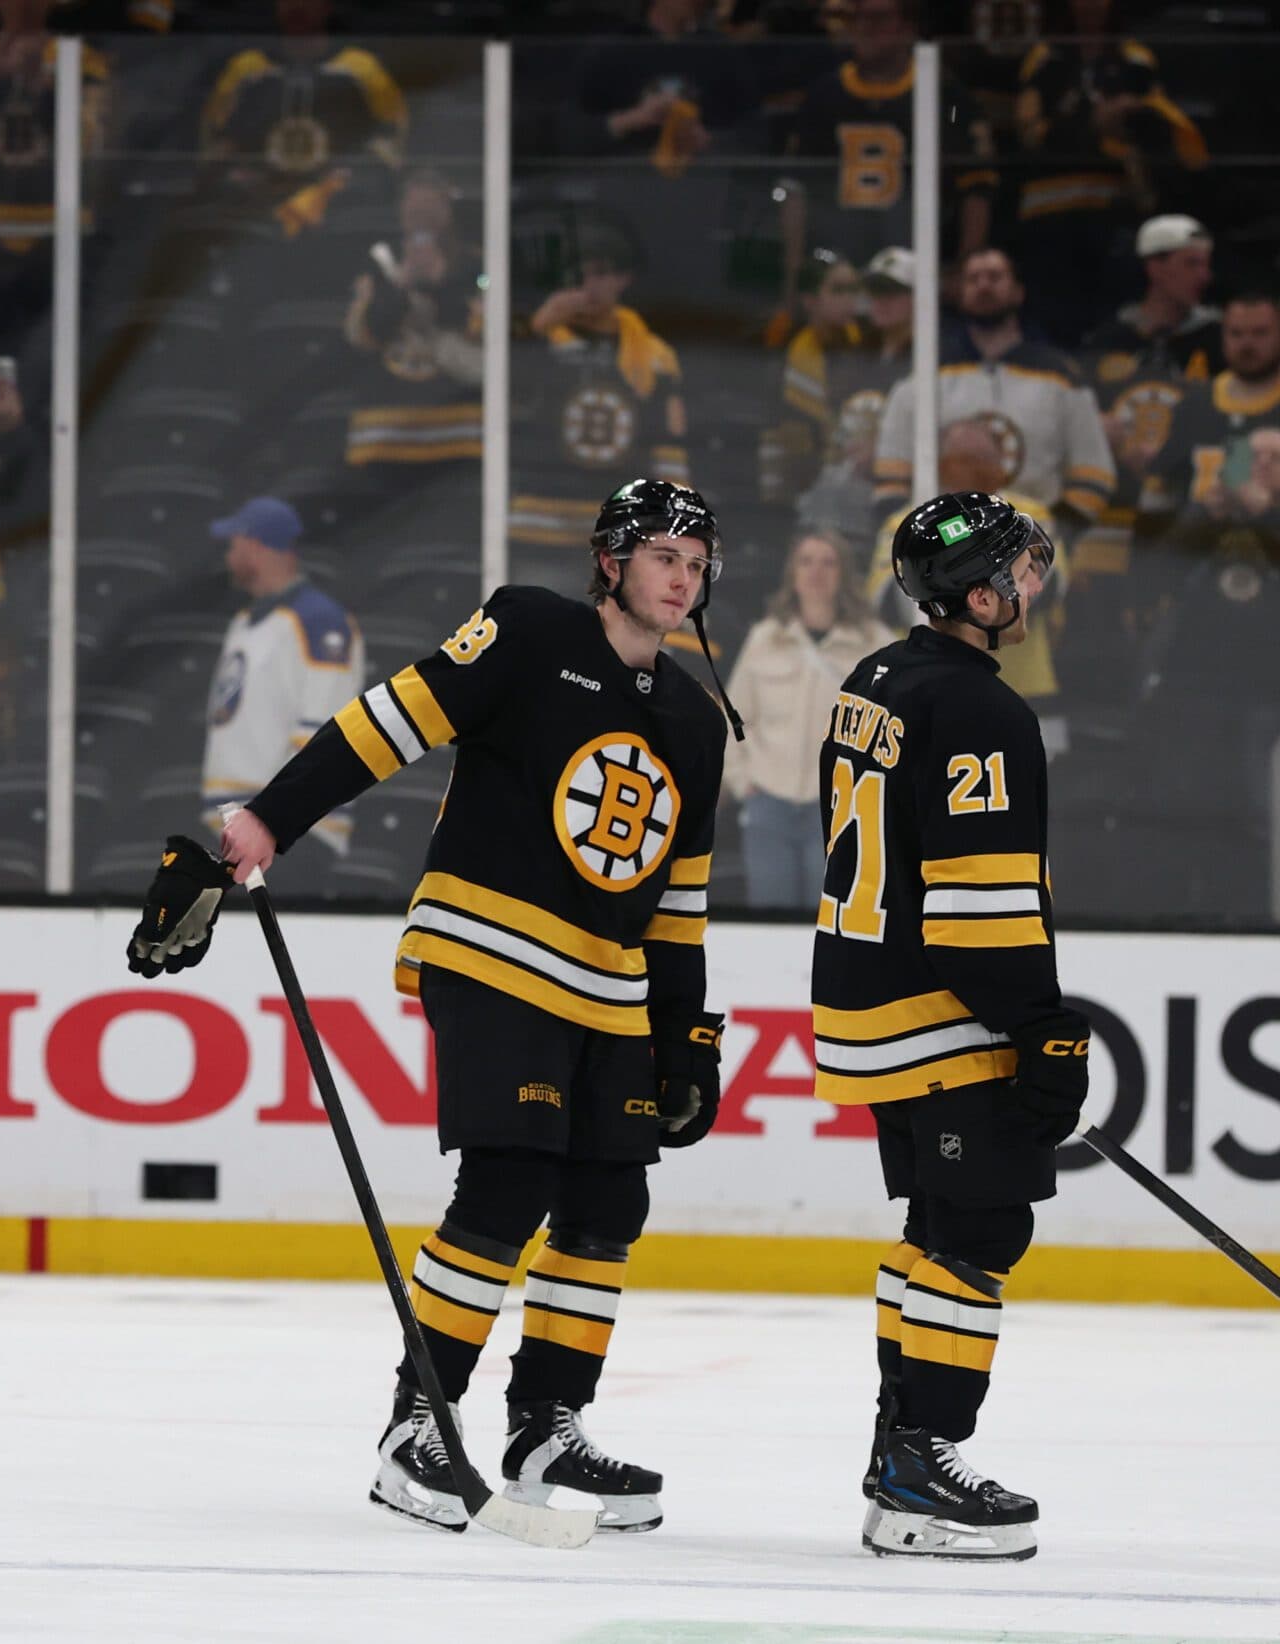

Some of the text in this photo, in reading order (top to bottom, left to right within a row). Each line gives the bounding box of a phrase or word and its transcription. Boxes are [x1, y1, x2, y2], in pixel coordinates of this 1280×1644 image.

[839, 124, 903, 208] B
[941, 520, 969, 539] TD
[588, 762, 654, 861] B
[947, 751, 1010, 815] 21
[816, 755, 887, 944] 21
[519, 1087, 561, 1108] BRUINS
